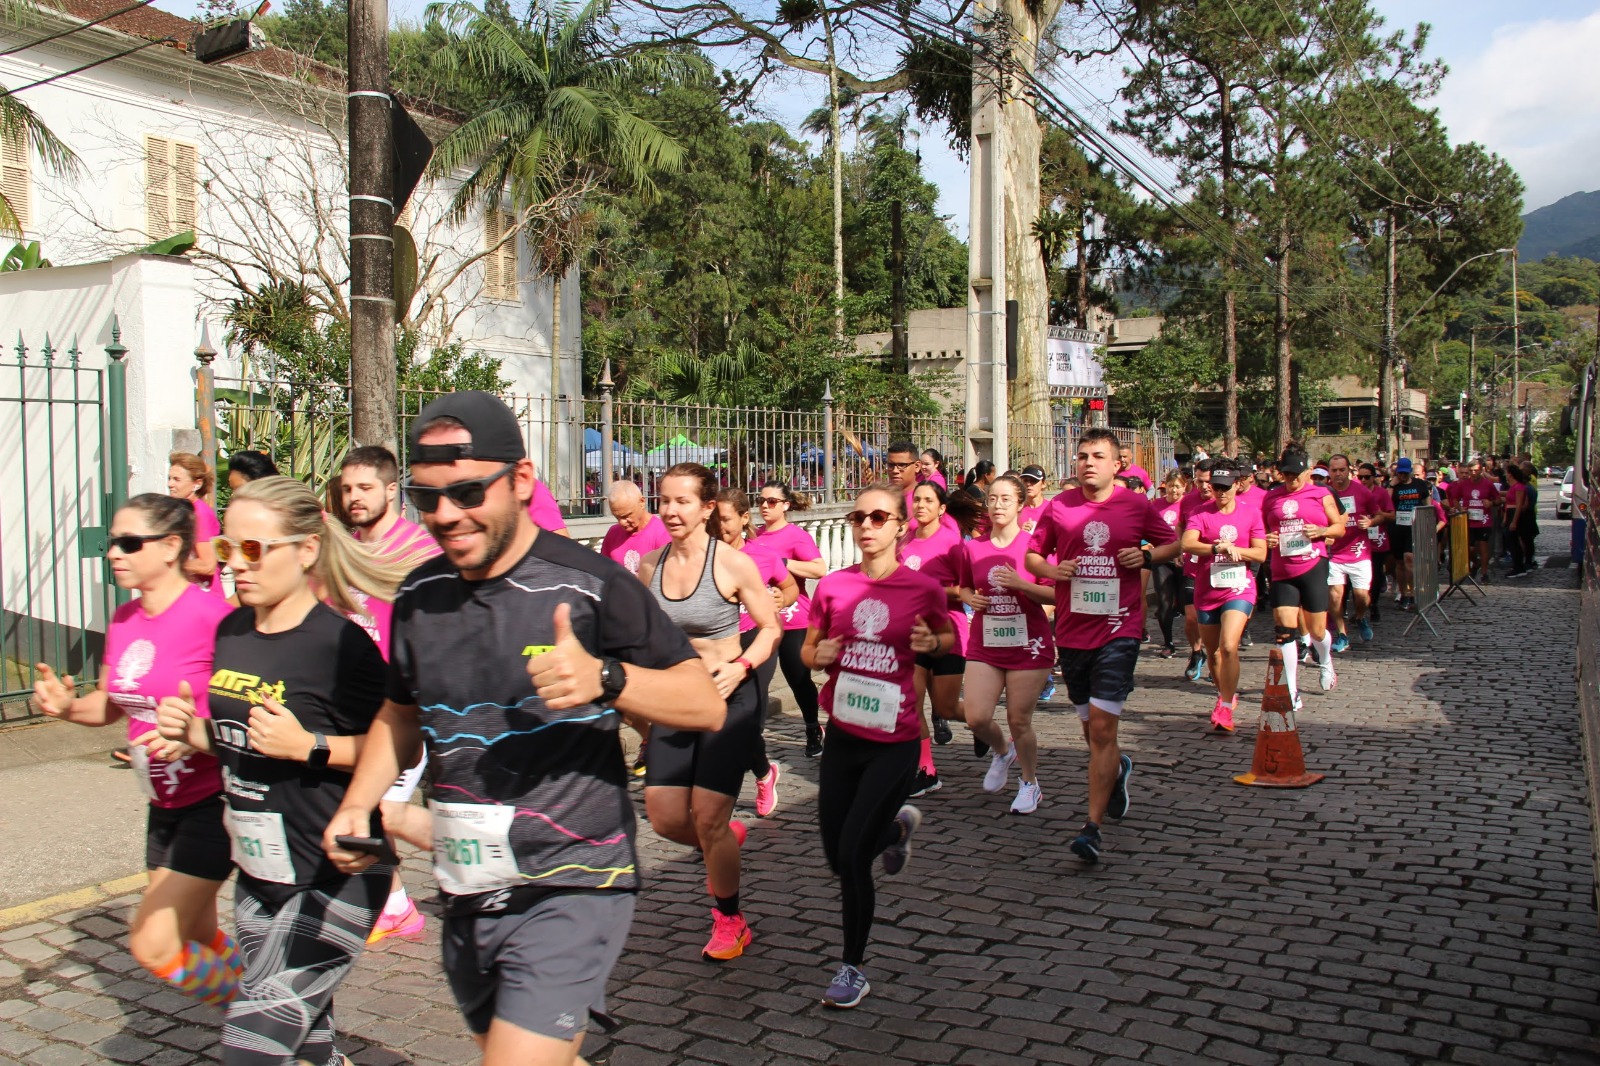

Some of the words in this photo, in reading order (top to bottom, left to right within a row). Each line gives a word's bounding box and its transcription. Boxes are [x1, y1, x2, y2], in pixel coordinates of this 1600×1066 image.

[1076, 555, 1116, 566] CORRIDA
[1220, 571, 1236, 580] 5111
[1083, 591, 1106, 603] 5101
[993, 627, 1016, 637] 5070
[840, 653, 899, 674] DASERRA
[847, 691, 881, 714] 5193
